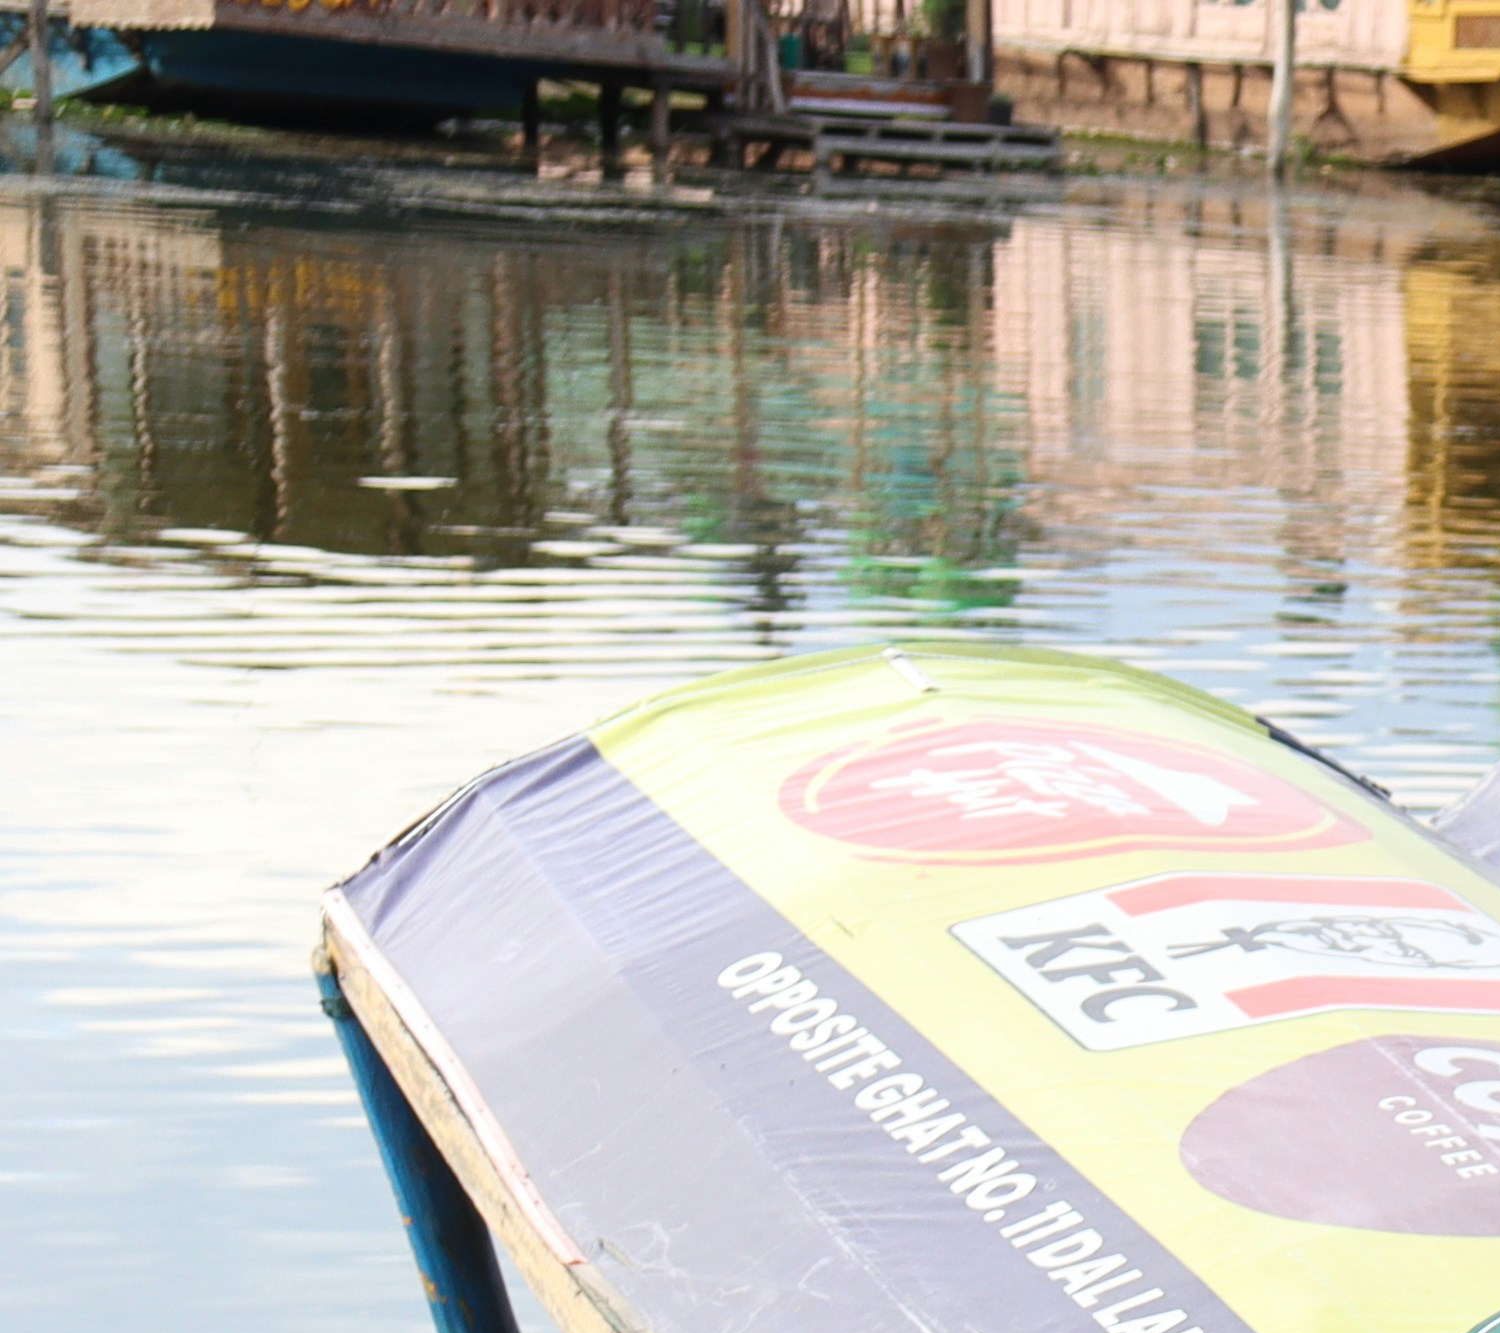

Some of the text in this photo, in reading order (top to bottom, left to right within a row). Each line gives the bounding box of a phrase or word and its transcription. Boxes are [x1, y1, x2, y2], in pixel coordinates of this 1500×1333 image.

[999, 921, 1199, 1024] KFC
[717, 951, 902, 1091] OPPOSITE
[854, 1072, 990, 1164] GHAT
[1377, 1095, 1499, 1180] COFFEE
[937, 1146, 1037, 1223] NO.
[999, 1200, 1084, 1249] 11
[1027, 1228, 1144, 1309] DAL
